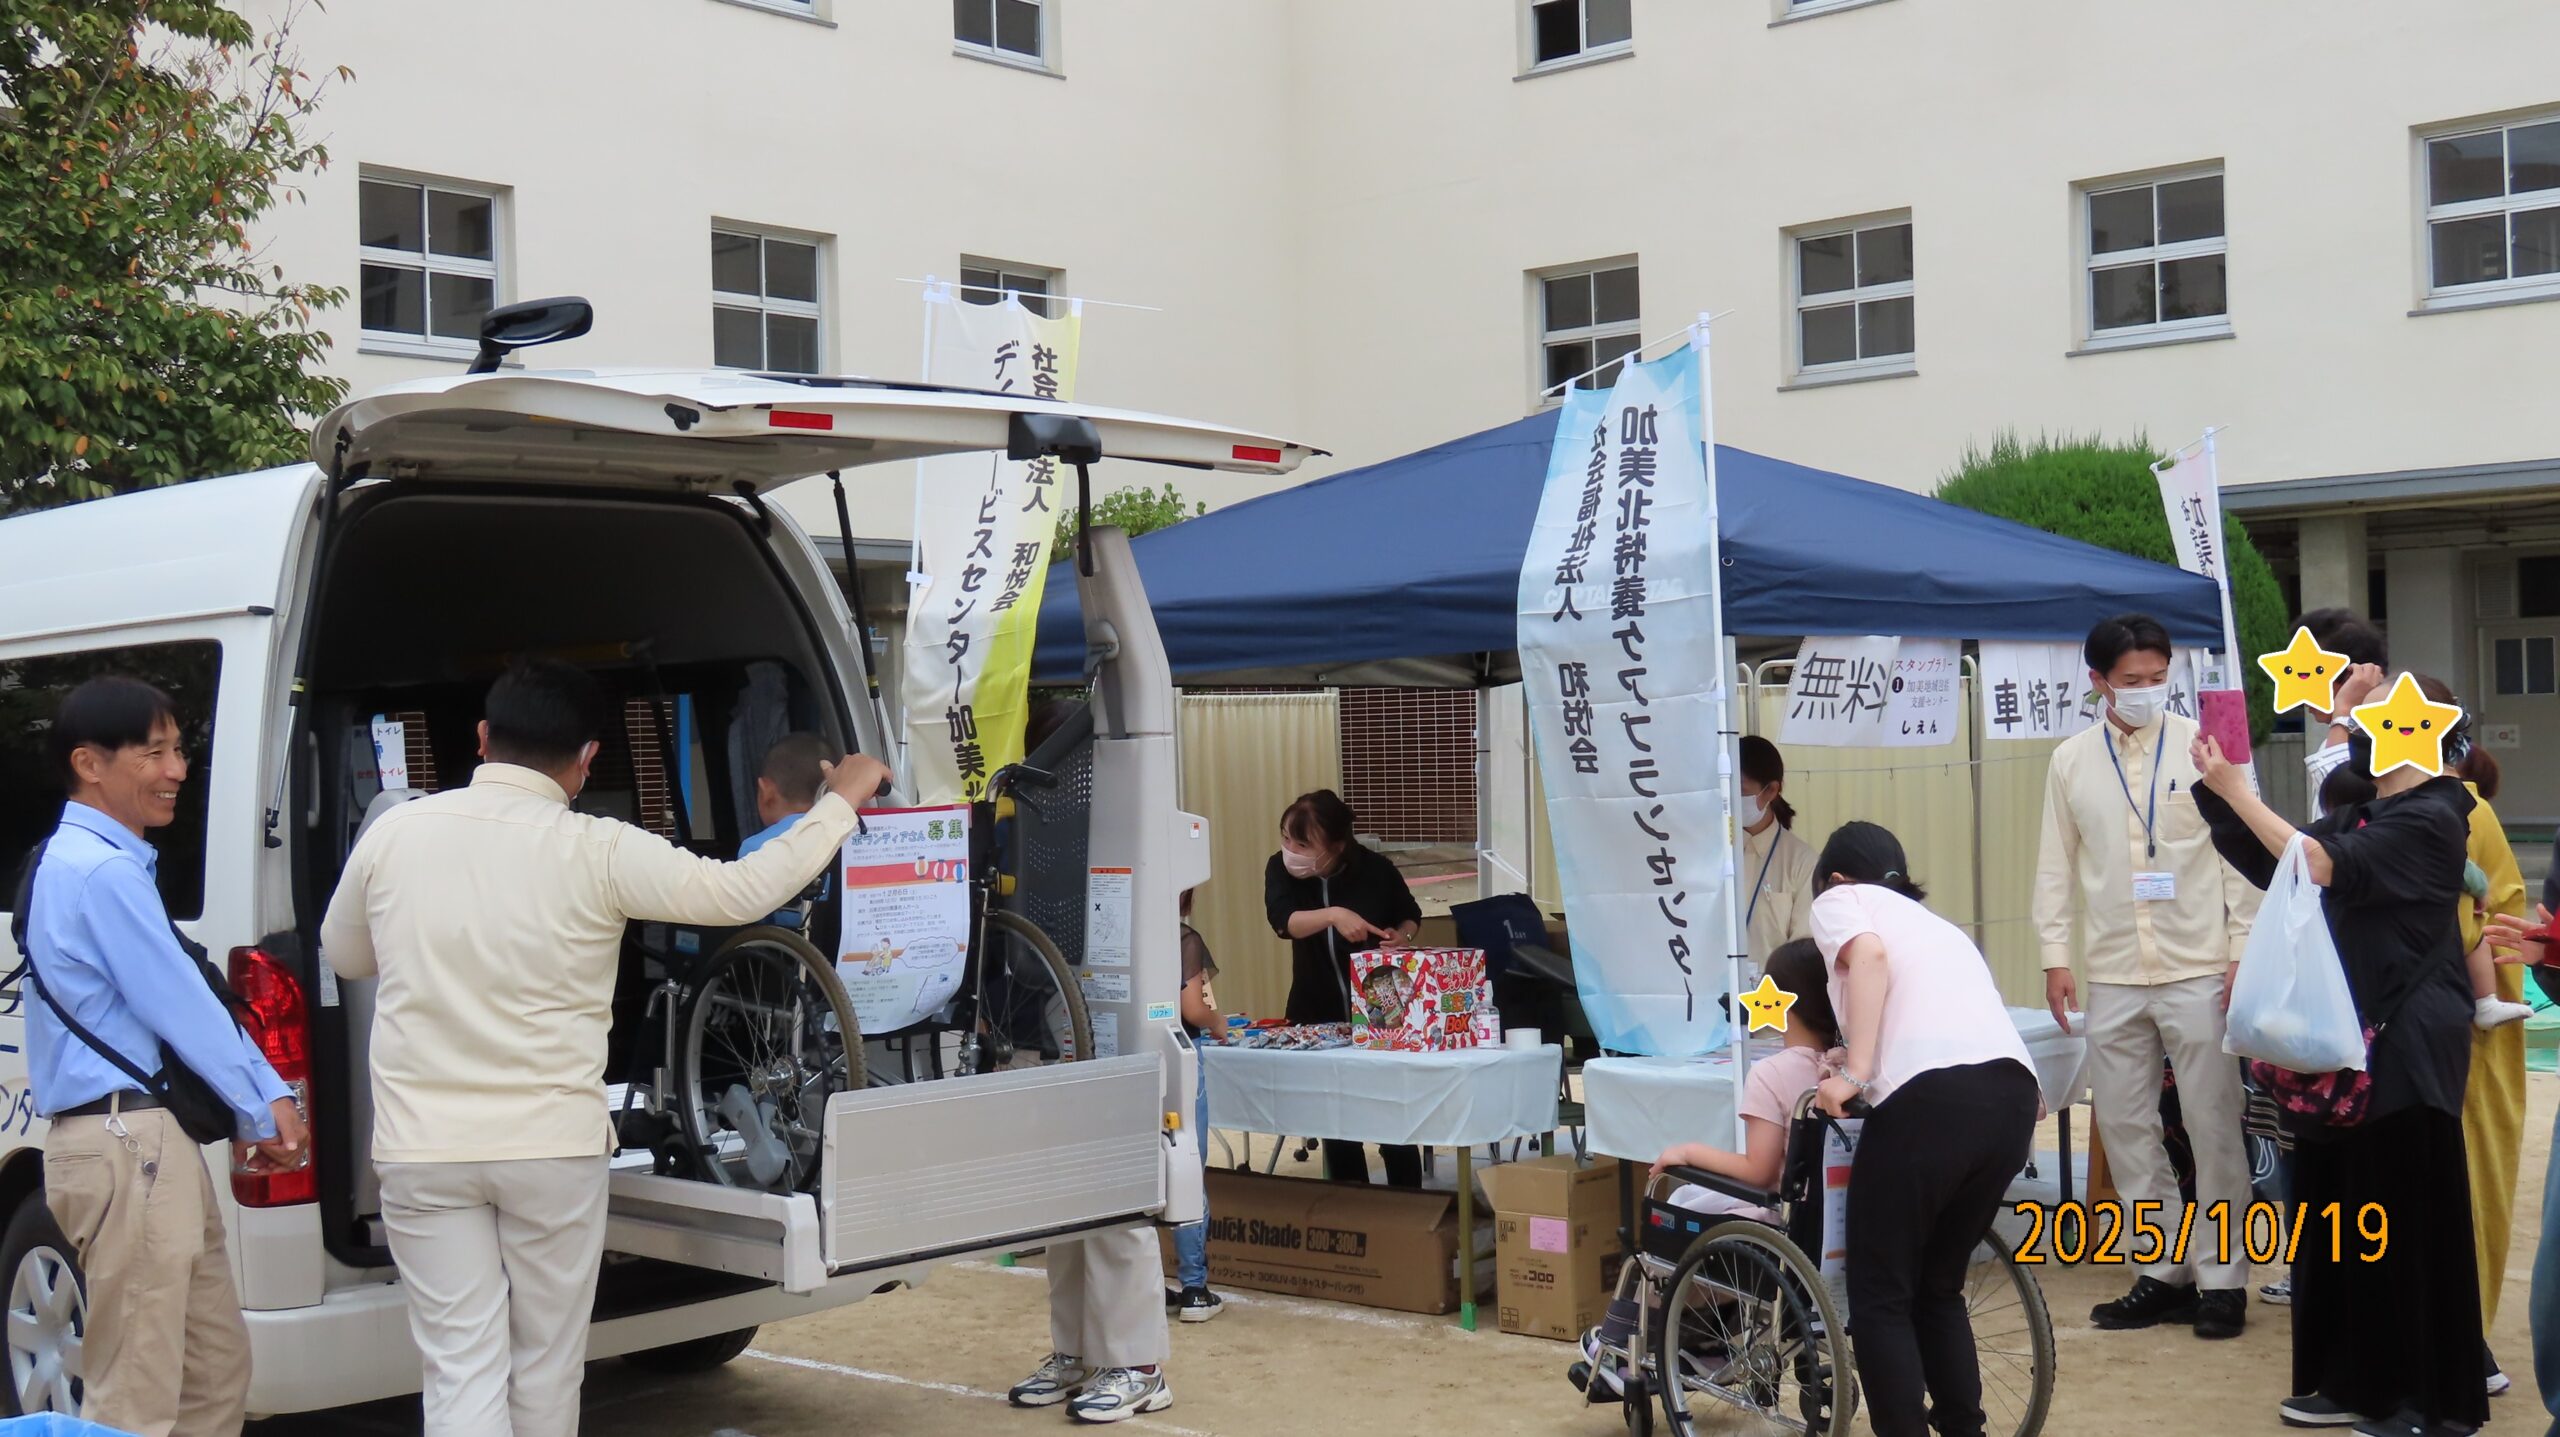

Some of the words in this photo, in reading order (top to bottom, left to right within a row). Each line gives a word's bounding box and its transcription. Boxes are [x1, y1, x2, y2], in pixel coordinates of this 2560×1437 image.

[1022, 343, 1059, 512] 社会法人
[990, 541, 1040, 612] 和悦会
[1894, 657, 1953, 672] スタンプラリー
[1791, 651, 1887, 724] 無料
[1993, 677, 2072, 734] 車椅子
[1901, 719, 1937, 735] しえん
[928, 818, 963, 840] 募集
[1153, 1009, 1170, 1017] リフト
[1444, 1013, 1472, 1035] BOX
[1205, 1215, 1246, 1243] uick
[1248, 1218, 1301, 1250] Shade
[1206, 1264, 1255, 1281] イックシェード
